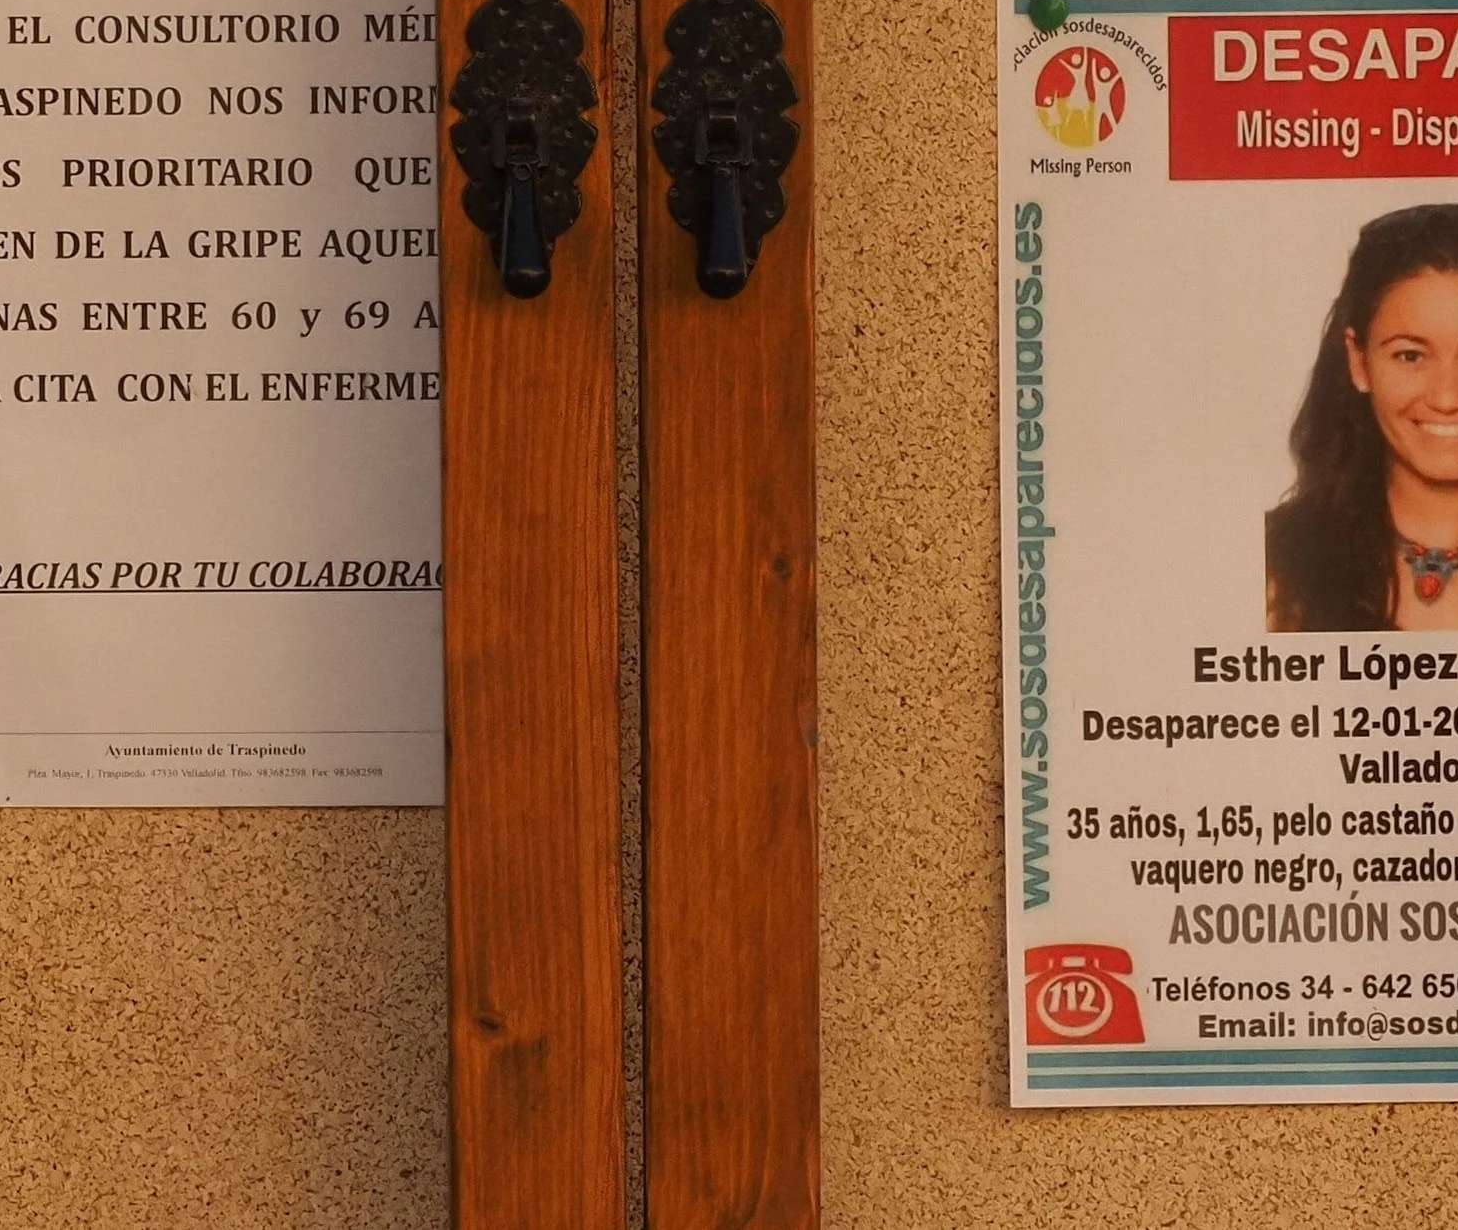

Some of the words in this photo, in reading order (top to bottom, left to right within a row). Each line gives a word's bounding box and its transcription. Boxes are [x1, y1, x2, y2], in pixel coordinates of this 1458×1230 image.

[8, 17, 50, 44] EL
[75, 15, 339, 44] CONSULTORIO
[1062, 17, 1168, 92] sosdesaparecidos
[1238, 109, 1359, 157] Missing
[1031, 159, 1081, 177] Missing
[1087, 158, 1131, 173] Person
[1014, 201, 1056, 911] www.sosdesaparecidos.es
[1194, 645, 1325, 683] Esther
[1339, 643, 1458, 691] López
[1083, 711, 1279, 748] Desaparece
[1291, 705, 1319, 737] el
[1169, 890, 1389, 945] ASOCIACIÓN
[1048, 980, 1102, 1014] 112
[1199, 1012, 1295, 1038] Email:
